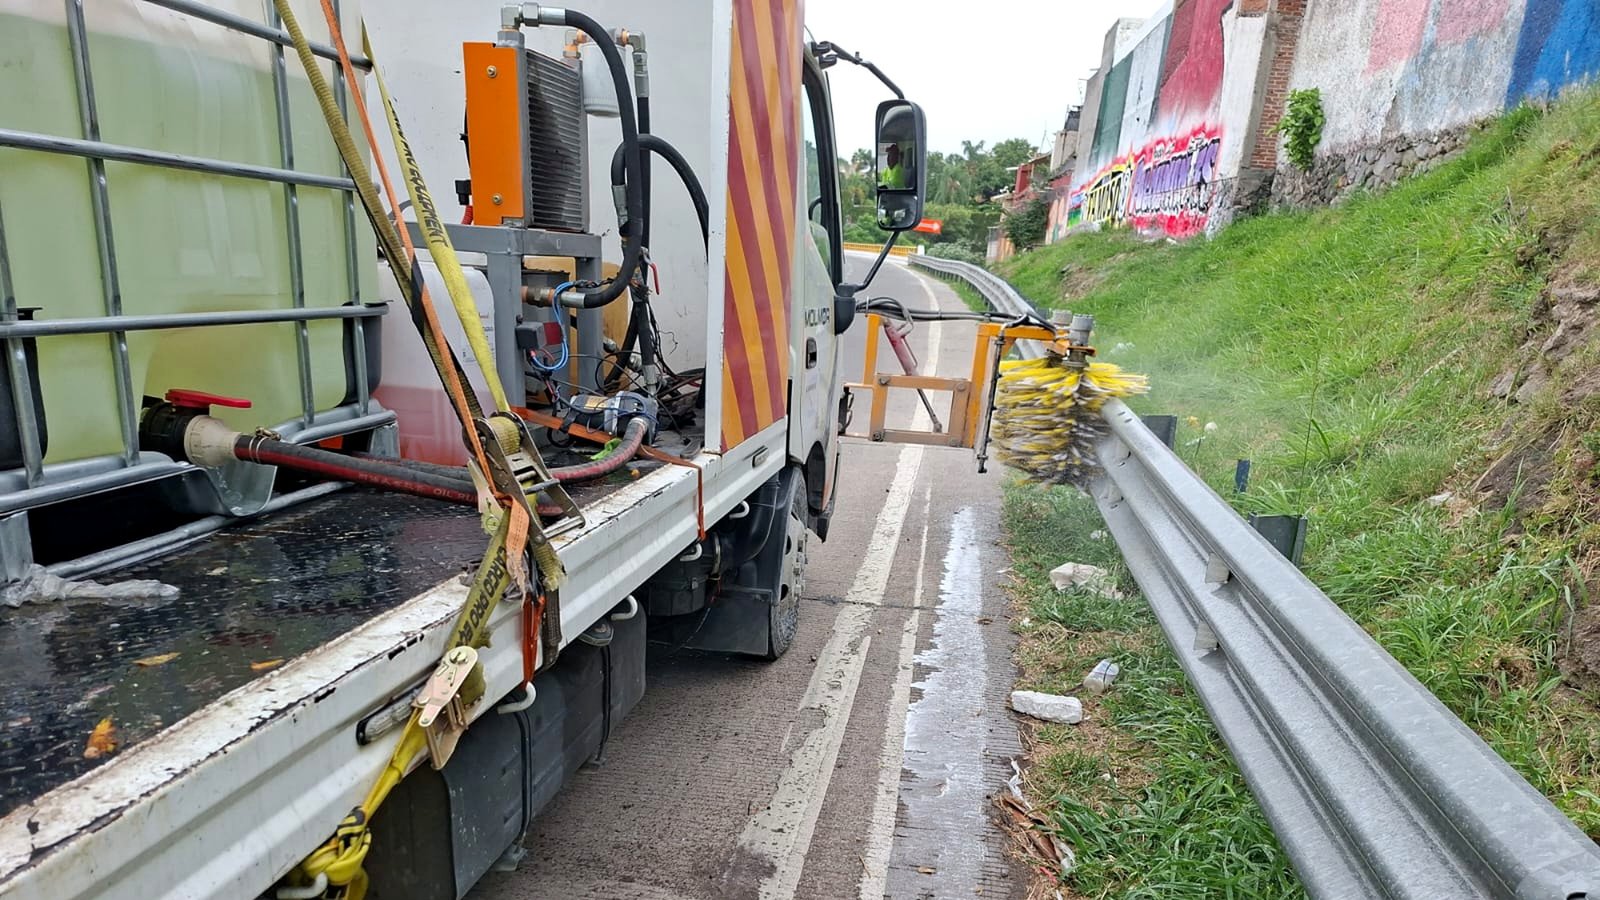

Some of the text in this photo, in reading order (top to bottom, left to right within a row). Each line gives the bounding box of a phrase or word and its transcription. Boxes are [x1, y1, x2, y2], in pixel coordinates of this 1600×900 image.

[410, 166, 449, 248] EQUIPMENT
[483, 545, 506, 598] CARGO
[469, 591, 489, 629] PRO
